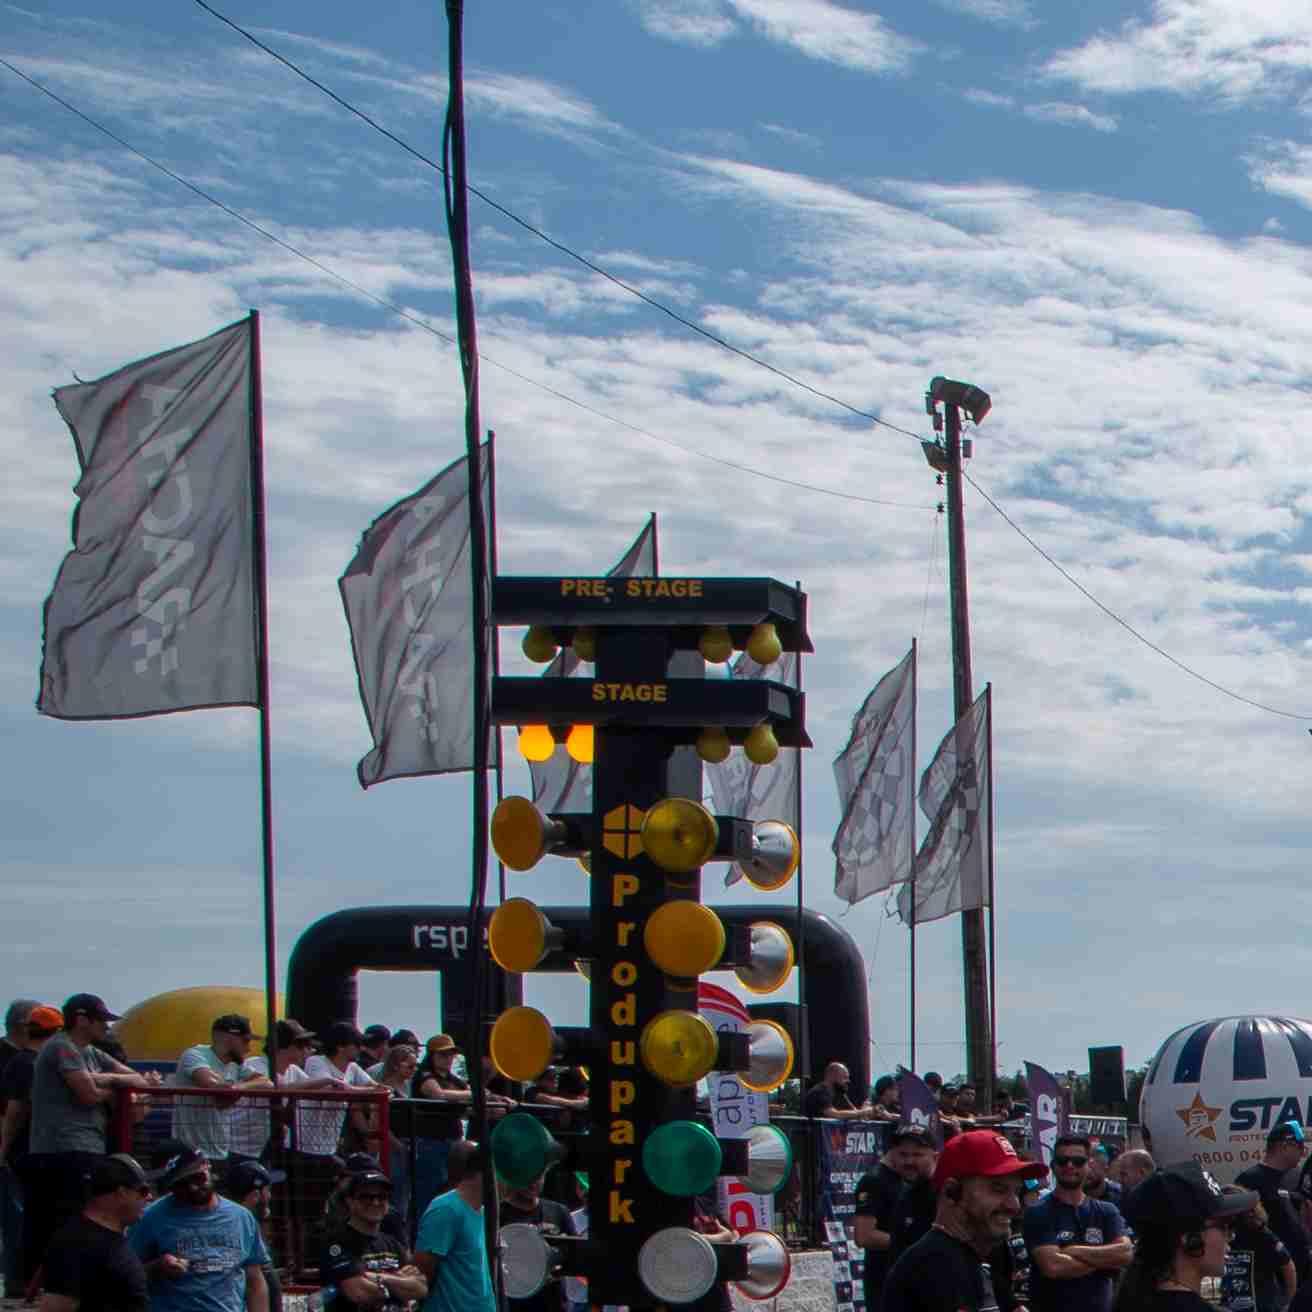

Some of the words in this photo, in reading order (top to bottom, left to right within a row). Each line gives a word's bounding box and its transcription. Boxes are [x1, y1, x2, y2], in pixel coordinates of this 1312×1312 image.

[626, 579, 704, 597] STAGE
[592, 684, 669, 702] STAGE
[845, 1131, 876, 1154] STAR
